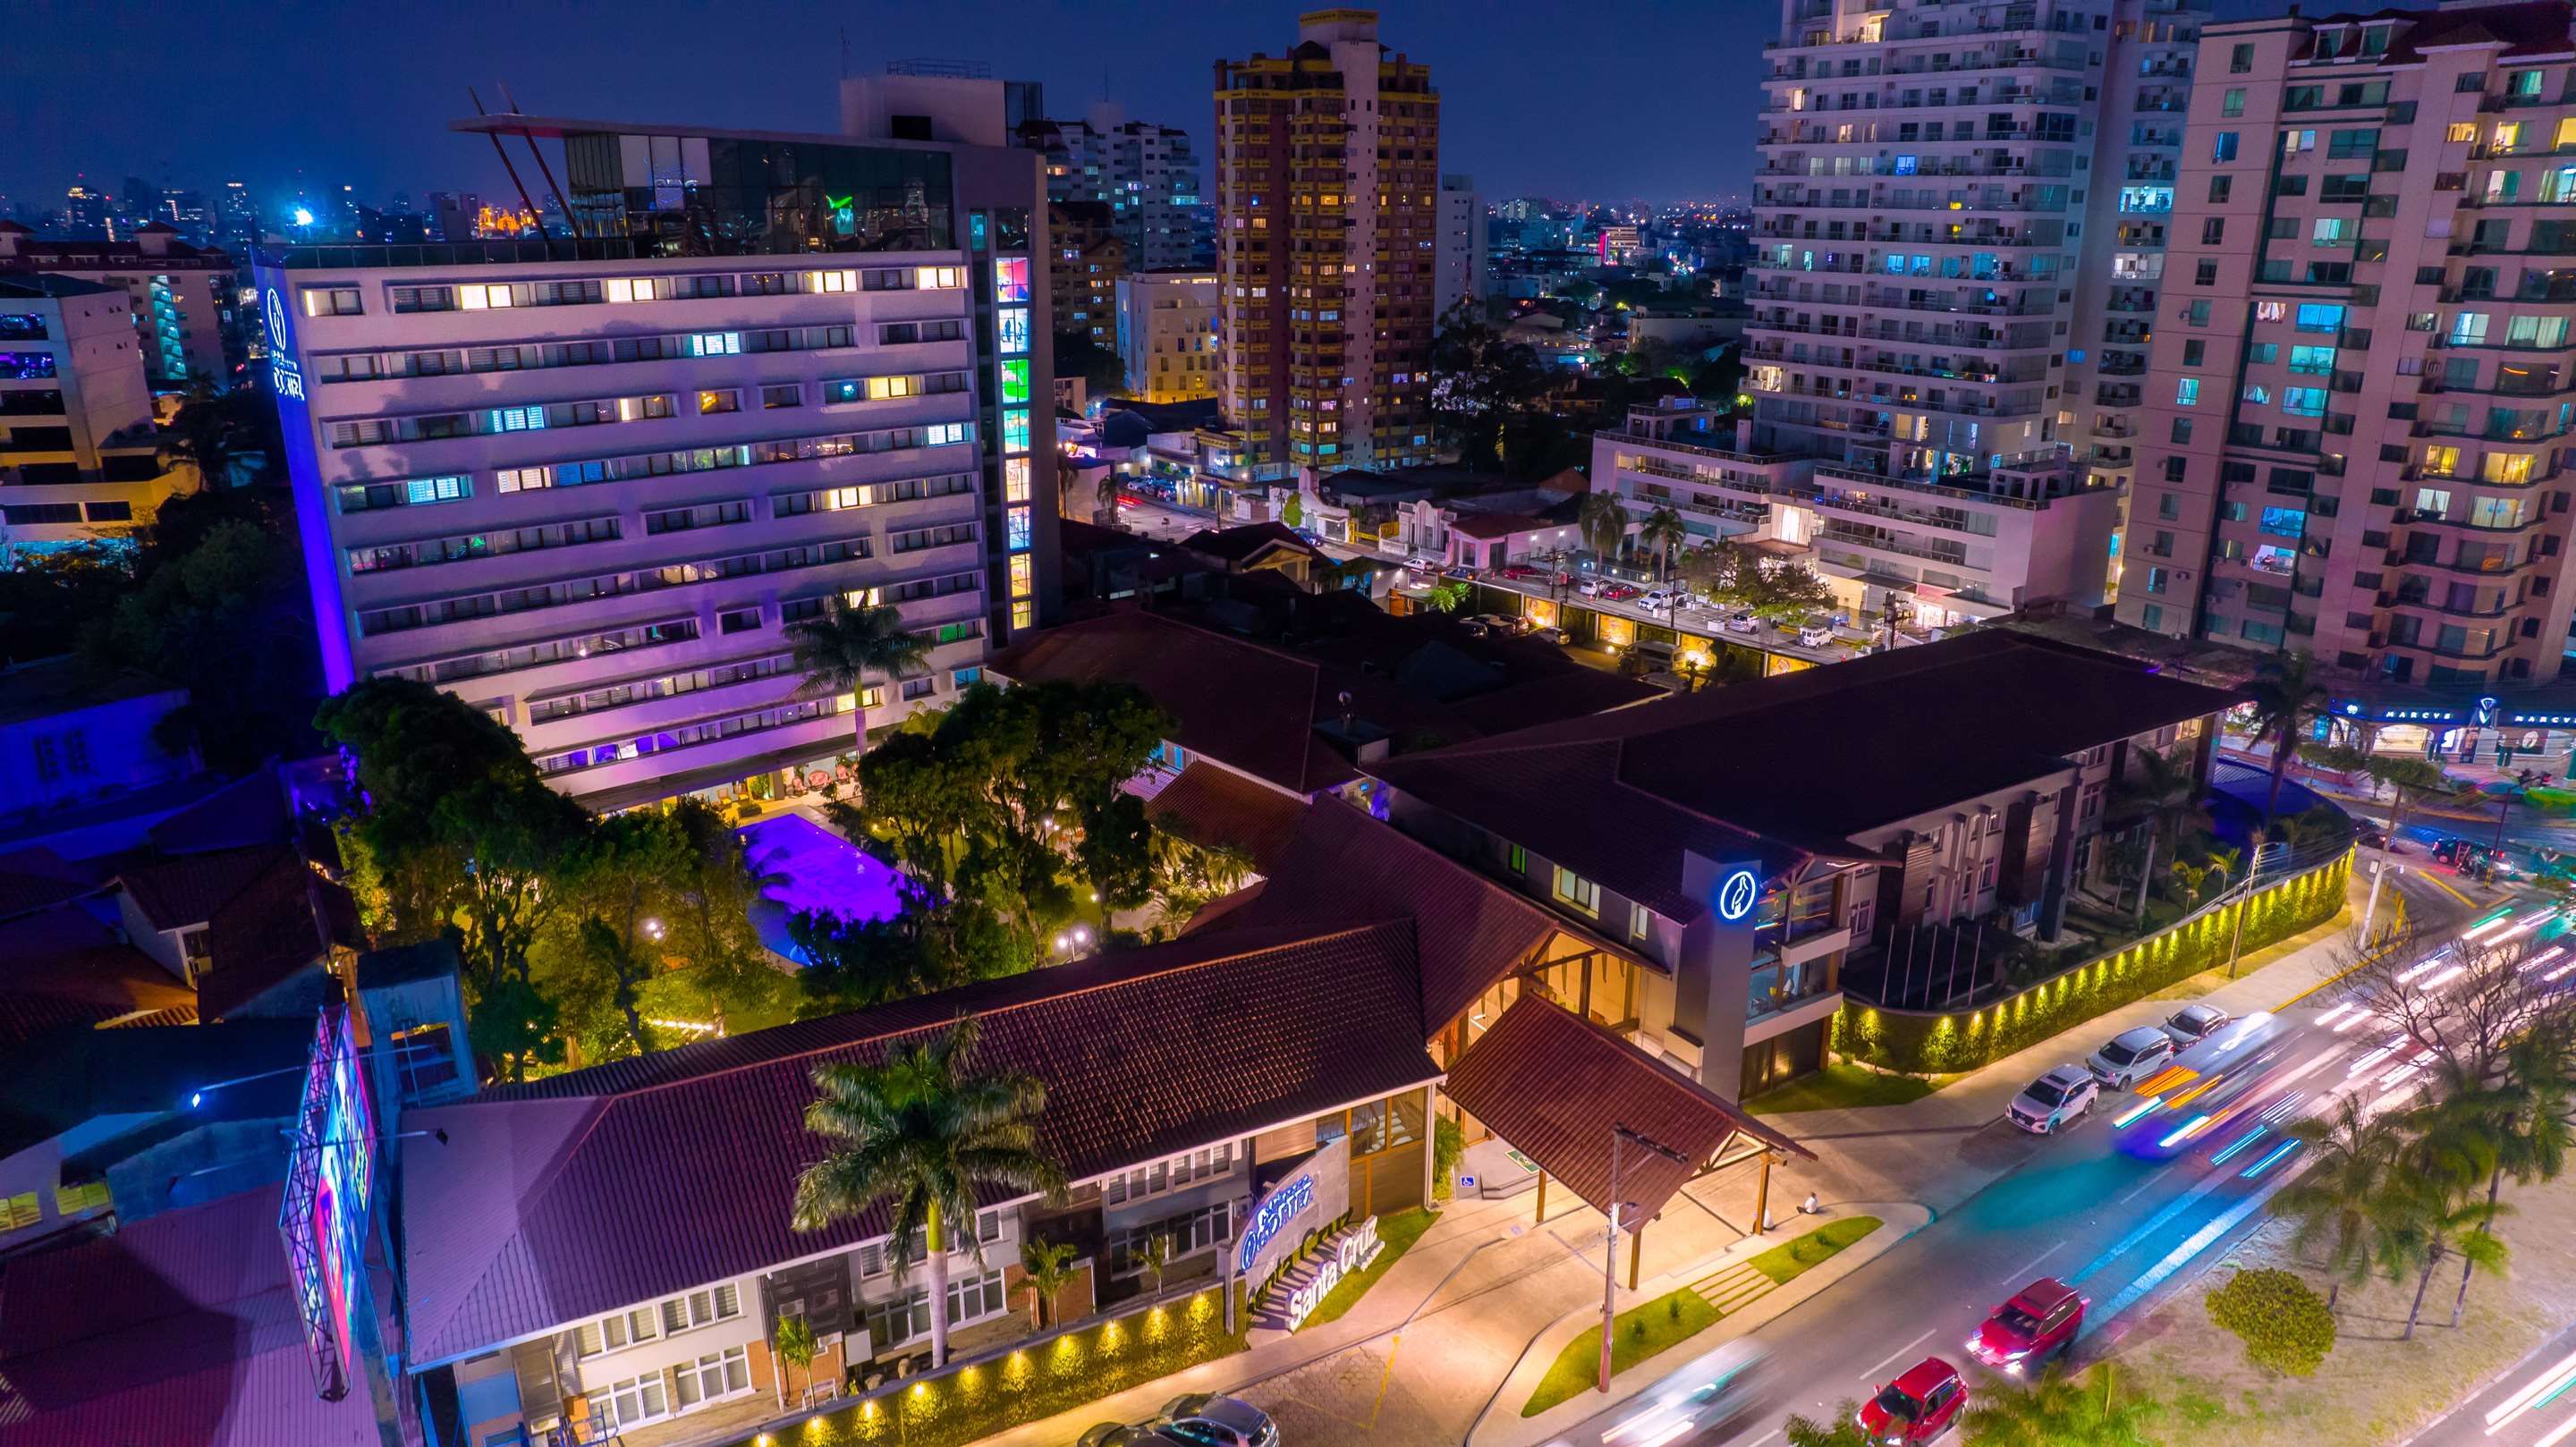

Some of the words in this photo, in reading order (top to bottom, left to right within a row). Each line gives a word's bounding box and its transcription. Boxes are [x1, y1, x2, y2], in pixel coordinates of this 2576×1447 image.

[2514, 715, 2576, 724] MARCV
[1288, 1260, 1339, 1333] Santa
[1339, 1214, 1378, 1274] Cruz
